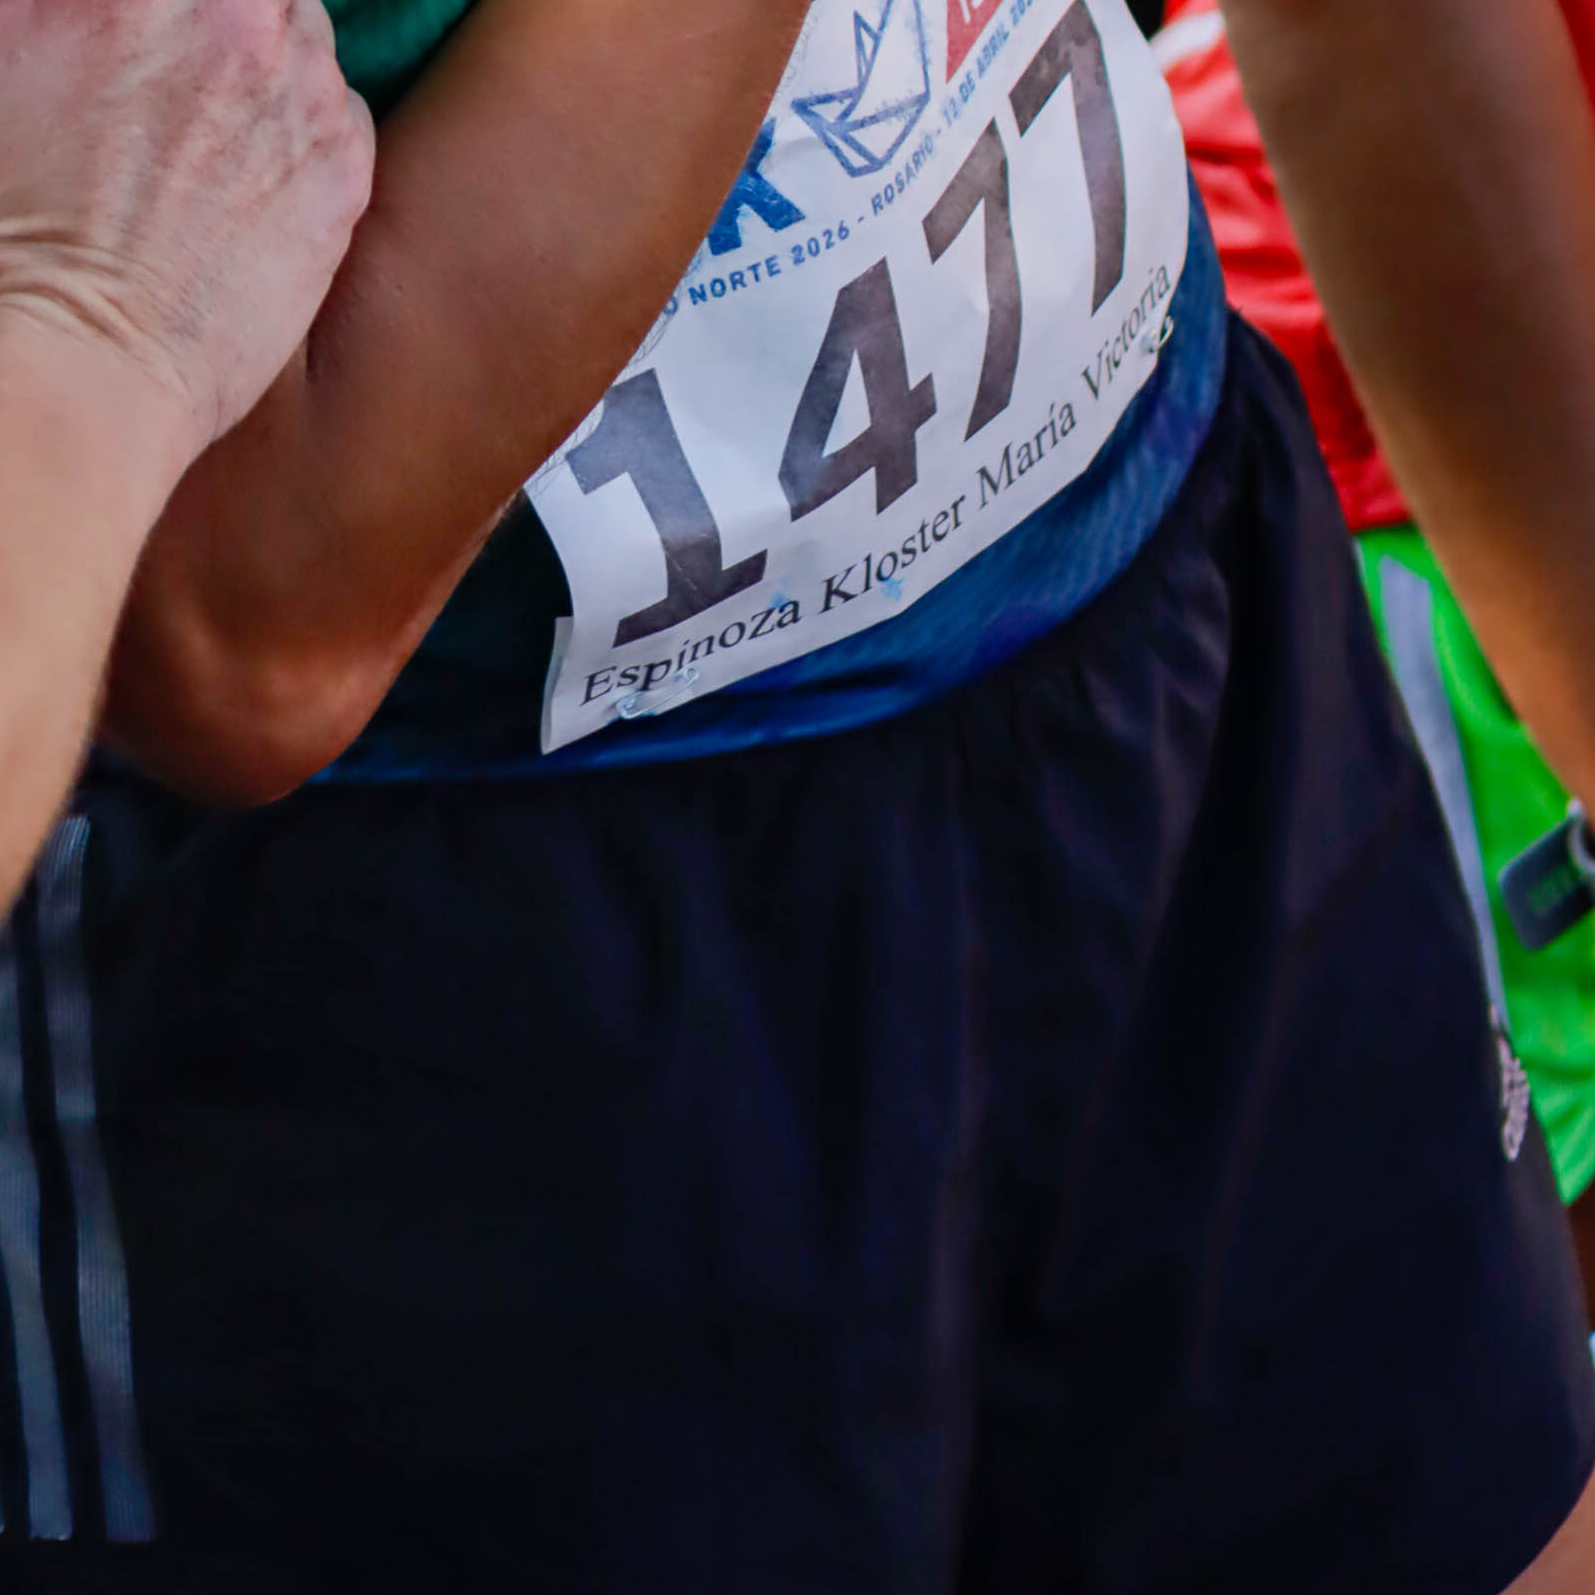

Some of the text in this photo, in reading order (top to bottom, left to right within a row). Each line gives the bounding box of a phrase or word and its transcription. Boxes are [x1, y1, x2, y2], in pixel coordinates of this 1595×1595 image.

[688, 255, 781, 308] NORTE
[791, 224, 851, 267] 2026
[871, 133, 935, 217] ROSARIO
[959, 71, 977, 104] DE
[976, 22, 1010, 80] ABRIL
[581, 264, 1173, 706] Espinoza Kloster María Victoria
